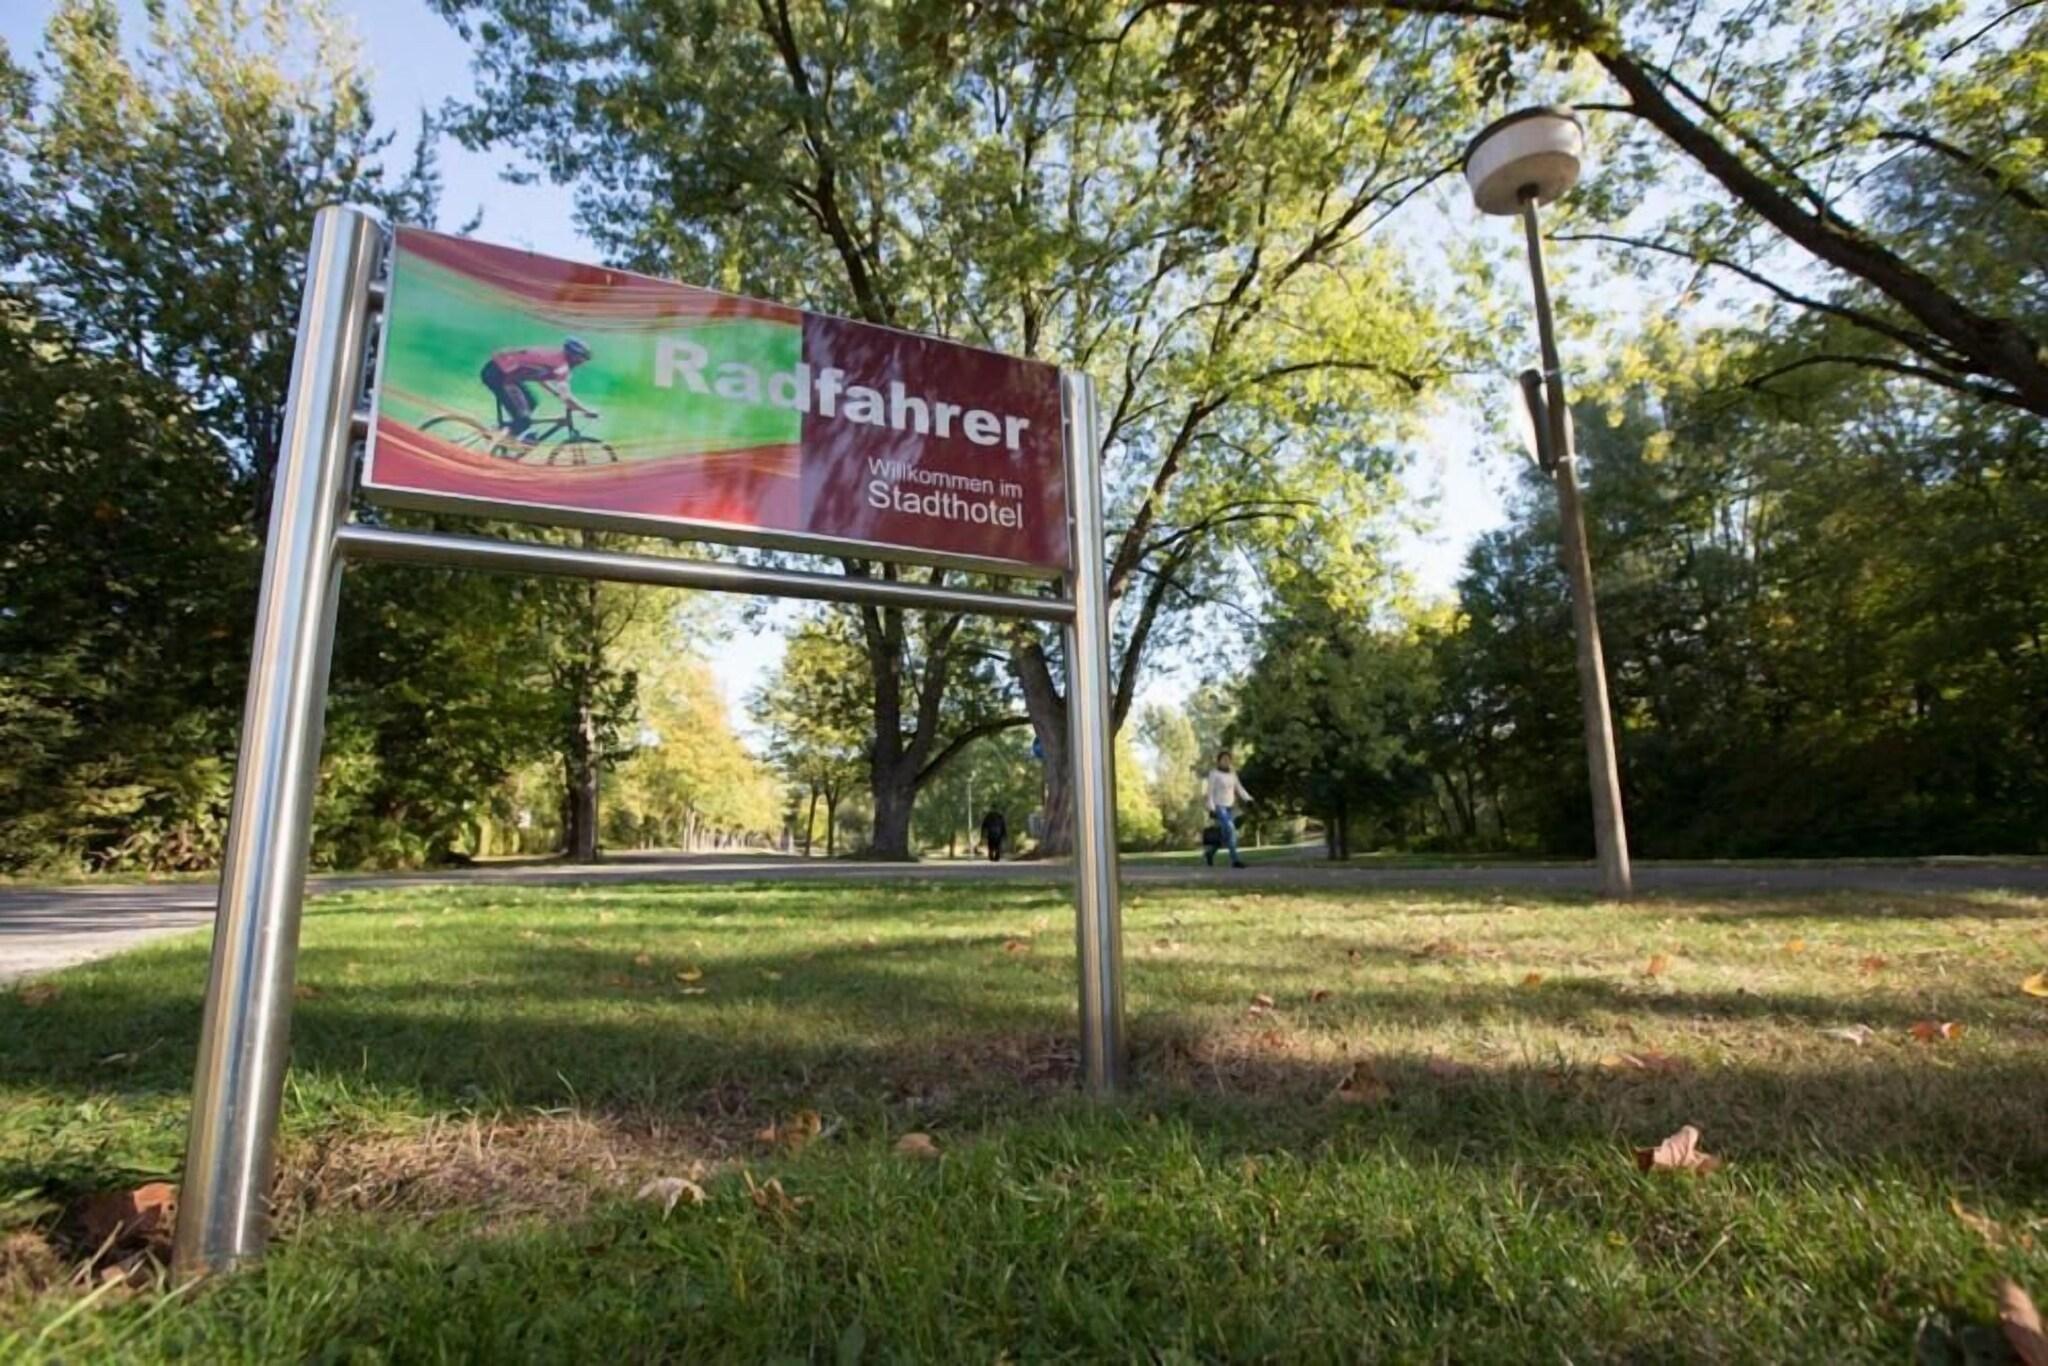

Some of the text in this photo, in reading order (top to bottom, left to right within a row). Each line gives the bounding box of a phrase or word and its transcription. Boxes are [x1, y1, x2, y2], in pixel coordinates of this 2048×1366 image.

[653, 336, 1031, 450] Radfahrer
[867, 455, 1024, 499] Willkommen im
[867, 479, 1024, 530] Stadthotel
